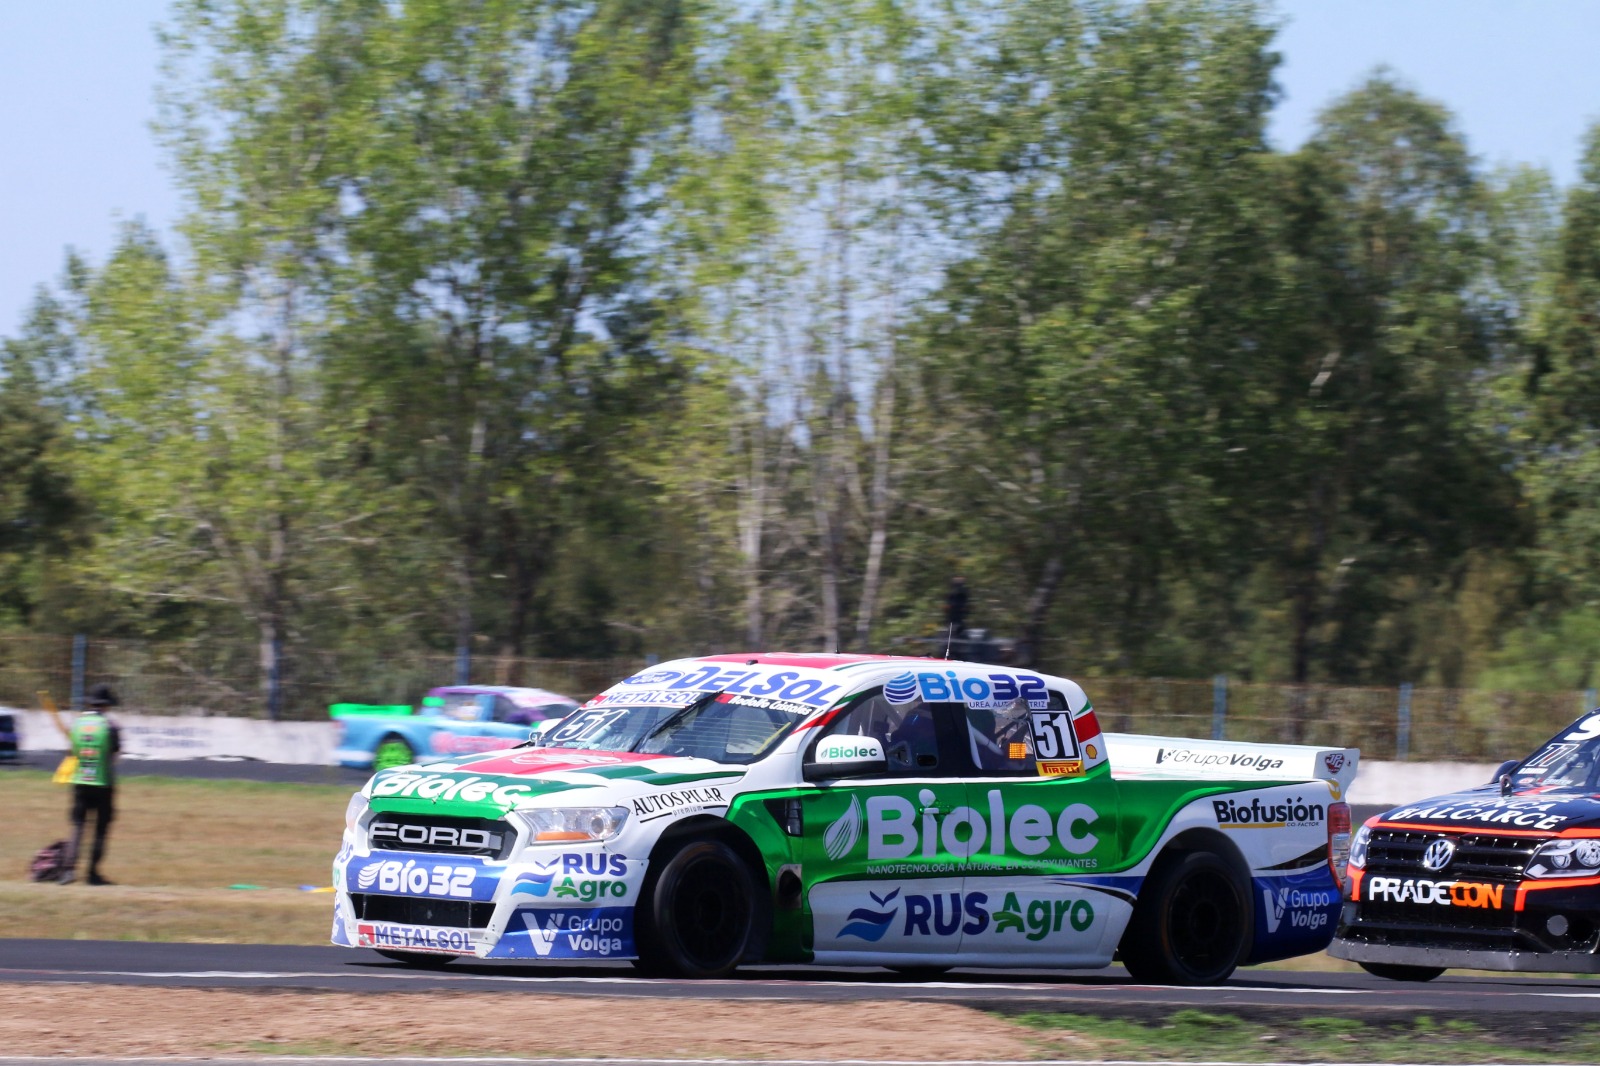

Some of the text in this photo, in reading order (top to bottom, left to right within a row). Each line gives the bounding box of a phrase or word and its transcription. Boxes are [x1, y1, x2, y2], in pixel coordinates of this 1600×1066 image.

[668, 666, 842, 705] DELSOL
[917, 671, 1049, 703] Bio32
[604, 692, 698, 705] METALSOL
[552, 709, 631, 741] 51
[1032, 713, 1075, 758] 51
[828, 746, 877, 758] Biolec
[1042, 762, 1081, 774] PIRELLI
[373, 773, 532, 807] Biolec
[632, 787, 727, 816] AUTOS PILAR
[672, 805, 703, 816] premium
[1212, 796, 1324, 823] Biofusión
[1389, 807, 1568, 830] BALCARCE
[368, 822, 492, 848] FORD
[866, 789, 1099, 860] Biolec
[563, 853, 627, 876] RUS
[867, 864, 955, 875] NANOTECNOLOGIA
[957, 862, 1004, 872] NATURAL
[379, 859, 476, 897] Bio32
[553, 876, 627, 901] Agro
[1291, 889, 1330, 908] Grupo
[1369, 877, 1505, 909] PRADECON
[568, 916, 623, 936] Grupo
[1291, 909, 1328, 930] Volga
[375, 926, 476, 951] METALSOL
[568, 934, 622, 955] Volga
